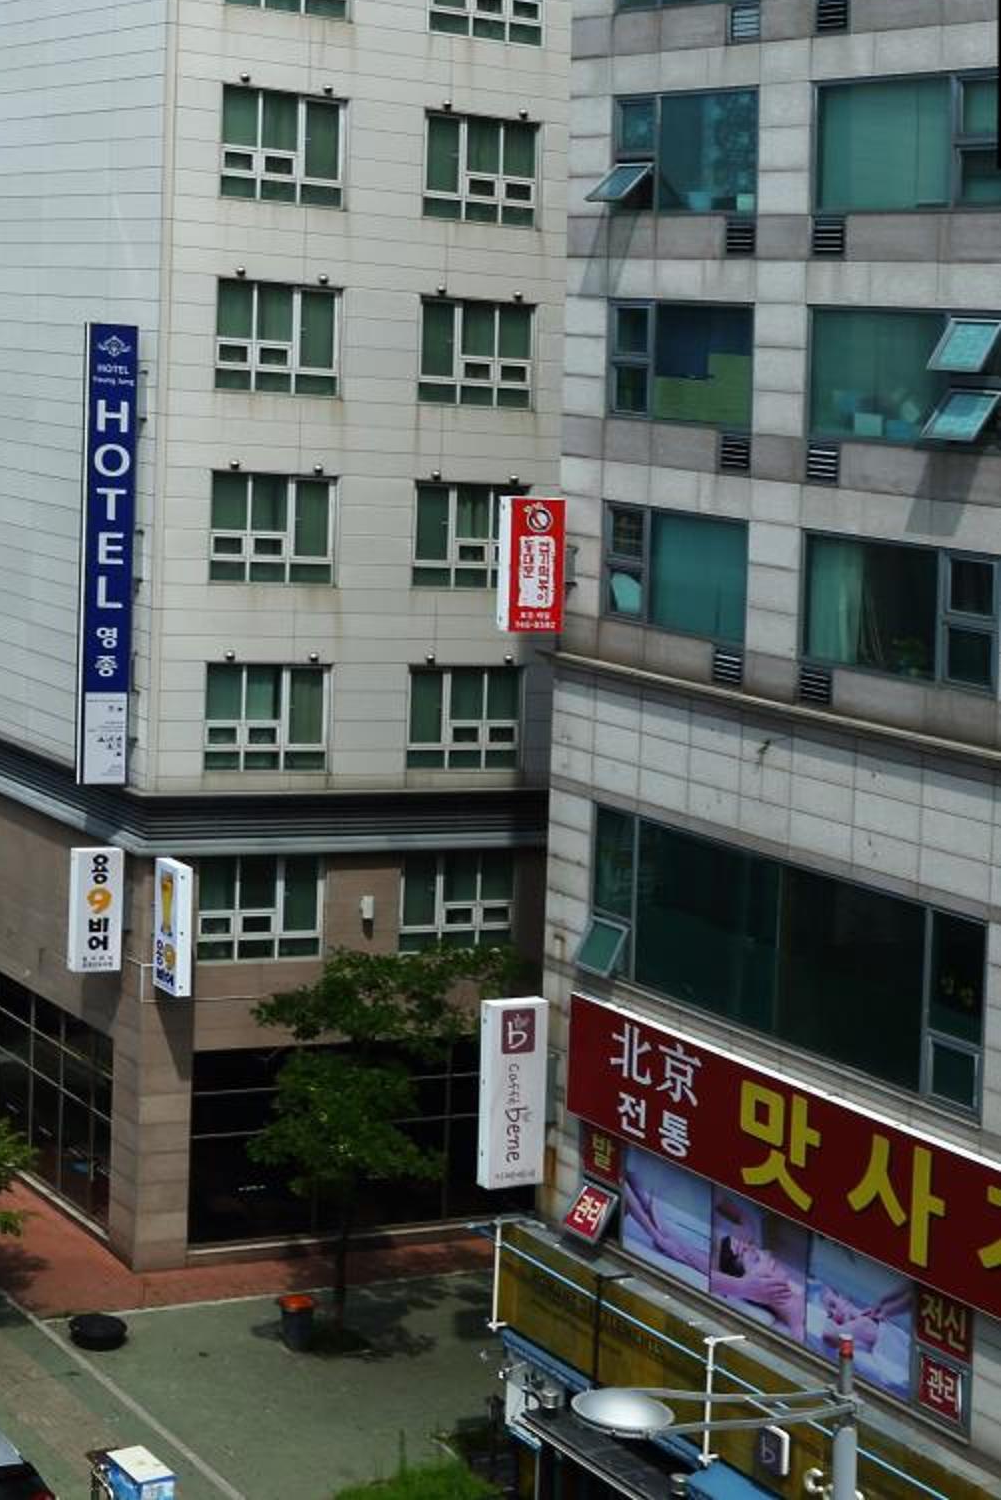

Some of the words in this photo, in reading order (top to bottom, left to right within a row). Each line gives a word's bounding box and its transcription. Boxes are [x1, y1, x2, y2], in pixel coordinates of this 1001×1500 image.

[97, 363, 130, 375] HOTEL
[94, 399, 131, 609] HOTEL
[95, 626, 118, 678] 영종
[610, 1022, 702, 1108] 北京
[617, 1091, 691, 1158] 전통
[920, 1292, 967, 1352] 전신
[926, 1365, 955, 1404] 관리
